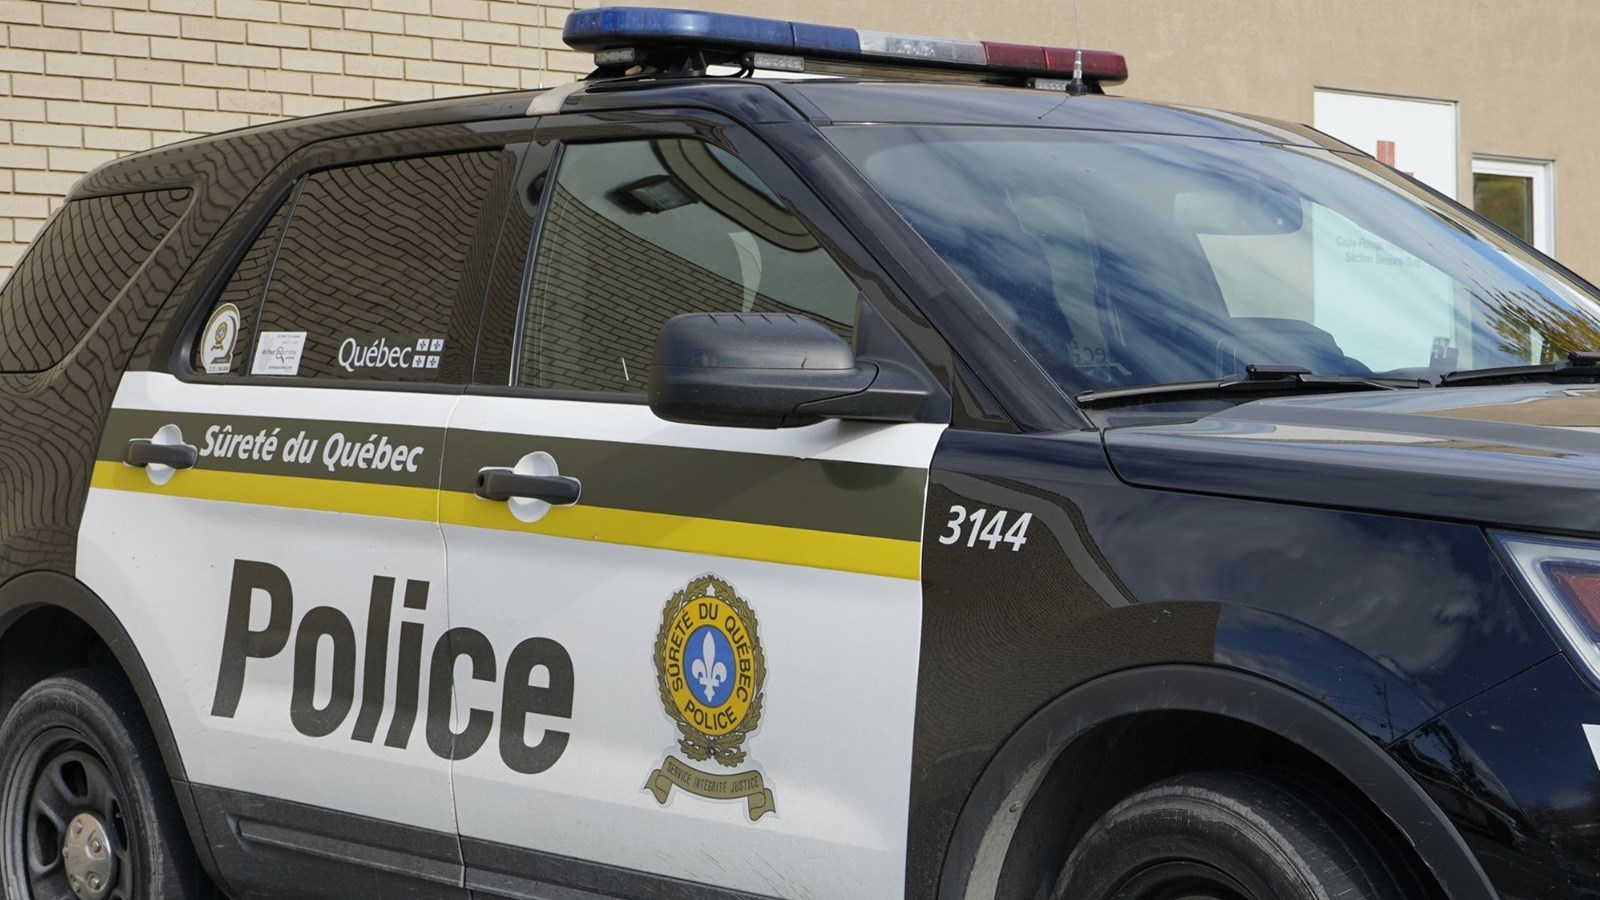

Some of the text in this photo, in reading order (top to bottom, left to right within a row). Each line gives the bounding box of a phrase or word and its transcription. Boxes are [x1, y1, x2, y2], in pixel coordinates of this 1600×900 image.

[338, 337, 412, 372] Québec
[199, 424, 424, 473] Sûreté du Québec
[938, 504, 1033, 552] 3144
[210, 558, 575, 775] Police
[667, 602, 752, 703] SÛRETÉ DU QUÉBEC
[684, 699, 738, 730] POLICE
[666, 761, 692, 785] SERVICE
[730, 775, 760, 793] JUSTICE
